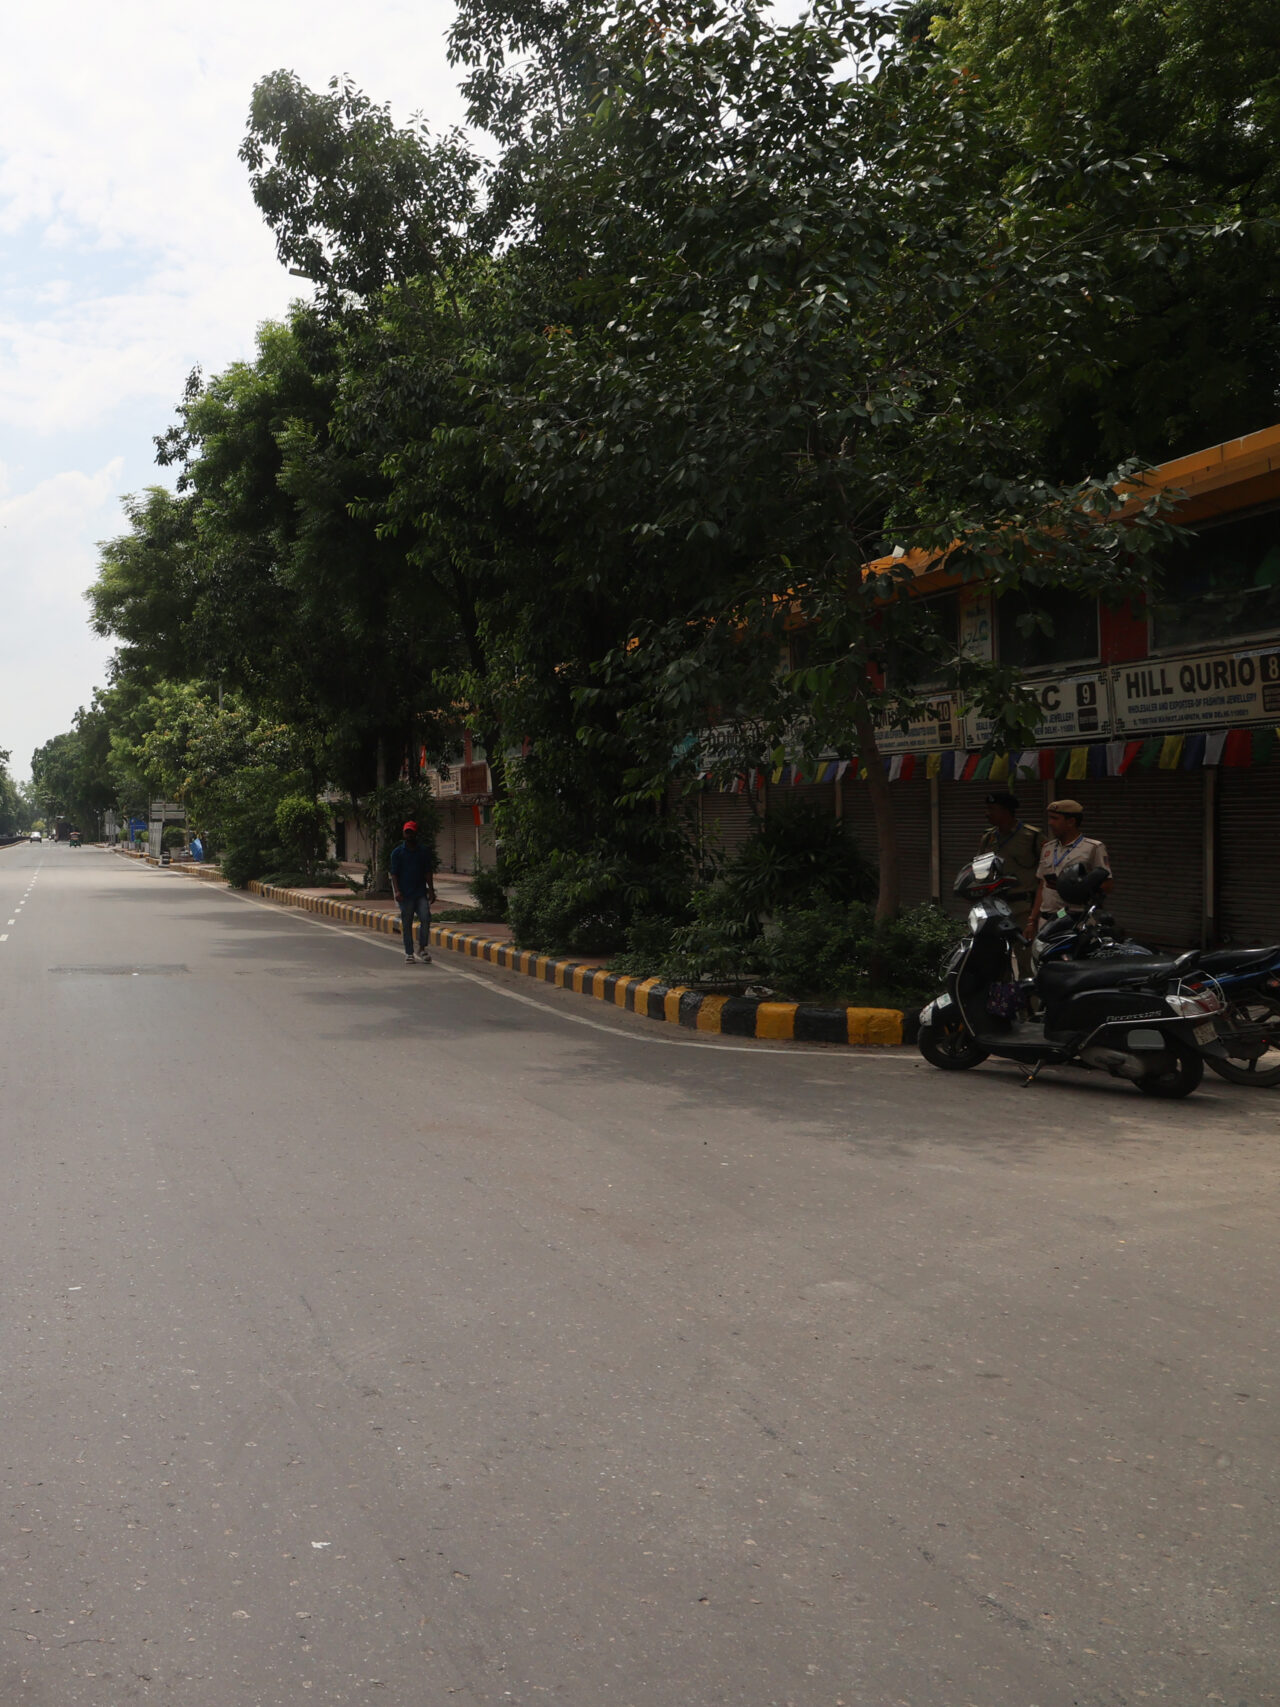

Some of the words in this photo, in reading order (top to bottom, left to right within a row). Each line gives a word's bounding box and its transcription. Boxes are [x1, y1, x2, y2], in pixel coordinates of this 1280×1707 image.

[1126, 669, 1173, 699] HILL
[1180, 658, 1255, 693] QURIO
[1226, 693, 1256, 704] JEWELLERY
[1049, 712, 1074, 723] JEWELLERY
